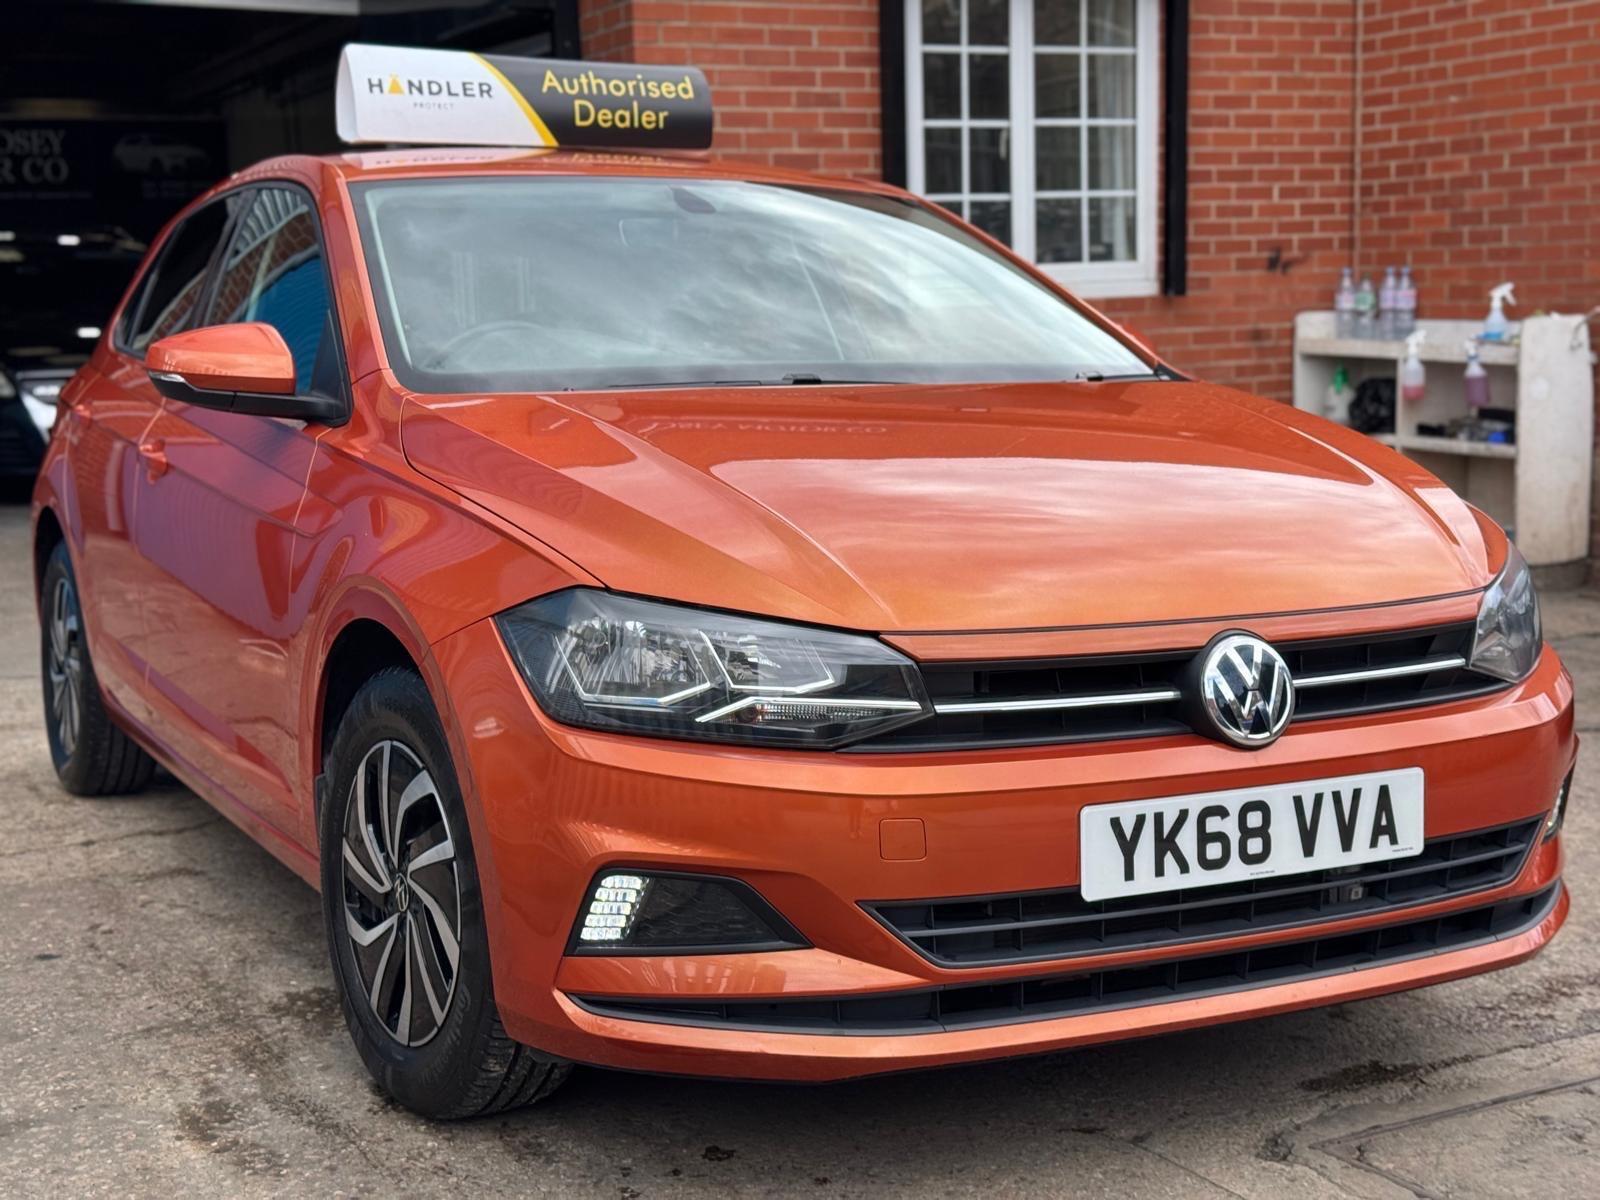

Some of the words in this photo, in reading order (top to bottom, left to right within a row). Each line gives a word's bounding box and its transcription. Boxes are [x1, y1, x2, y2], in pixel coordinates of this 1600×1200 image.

[541, 69, 694, 100] Authorised
[413, 102, 455, 110] PROTECT
[574, 99, 669, 130] Dealer
[21, 156, 69, 184] CO
[1109, 799, 1272, 882] YK68
[1292, 784, 1399, 858] VVA
